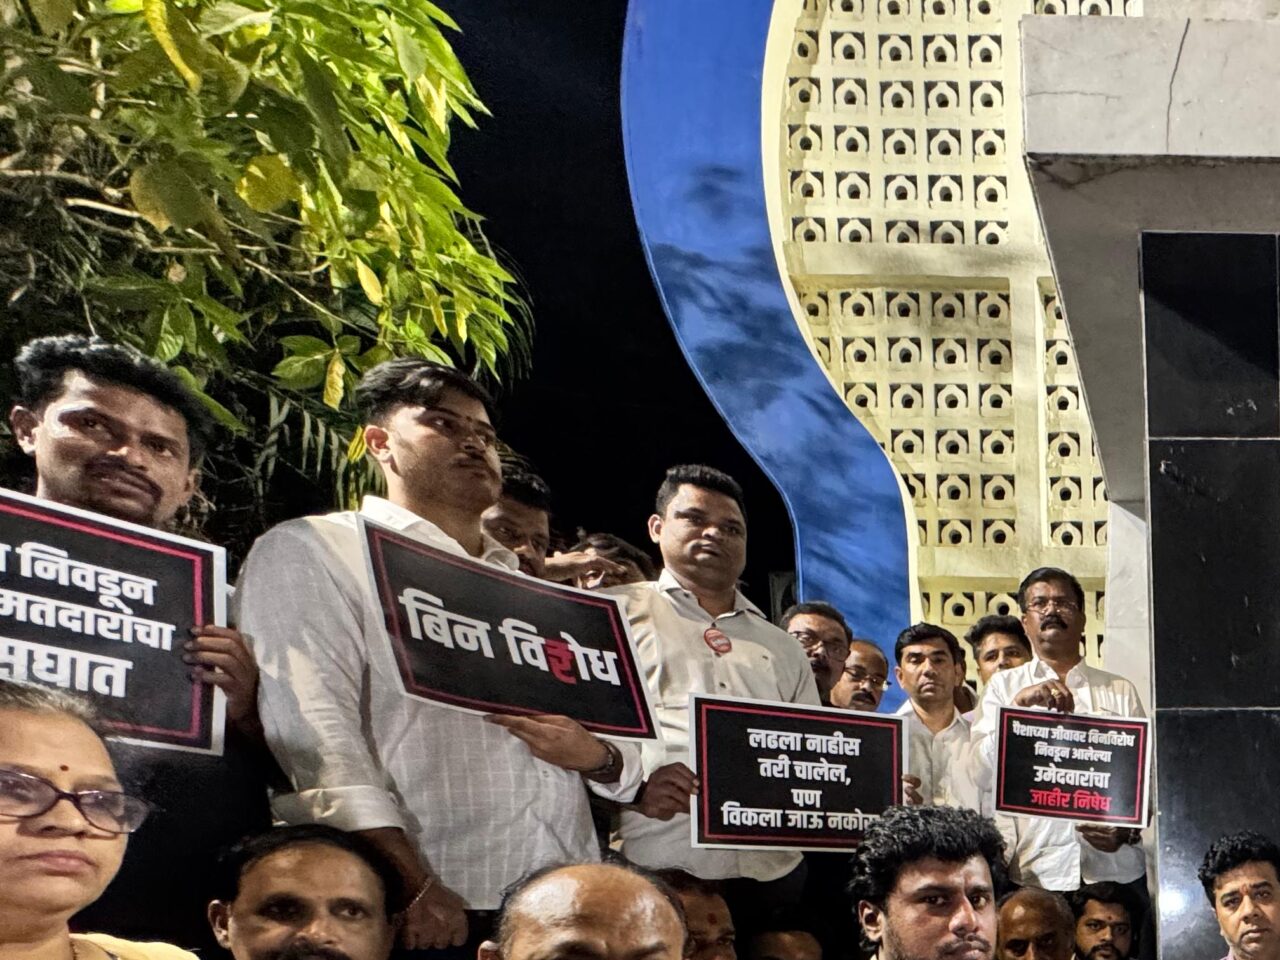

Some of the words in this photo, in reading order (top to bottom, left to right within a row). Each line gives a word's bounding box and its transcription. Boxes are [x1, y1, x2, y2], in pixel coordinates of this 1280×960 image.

[16, 542, 157, 614] निवडून
[398, 588, 495, 658] बिन
[747, 728, 802, 751] लढला
[804, 731, 861, 756] नाहीस
[1051, 725, 1086, 743] जीवावर
[1088, 729, 1135, 747] बिनविरोध
[1034, 741, 1070, 767] निवडून
[1071, 747, 1112, 763] आलेल्या
[758, 754, 792, 779] तरी
[793, 758, 852, 786] चालेल,
[1033, 763, 1111, 789] उमेदवारांचा
[791, 788, 822, 808] पण
[1030, 787, 1071, 807] जाहीर
[1074, 789, 1112, 812] निषेध
[721, 800, 783, 827] विकला
[785, 810, 824, 829] जाऊ
